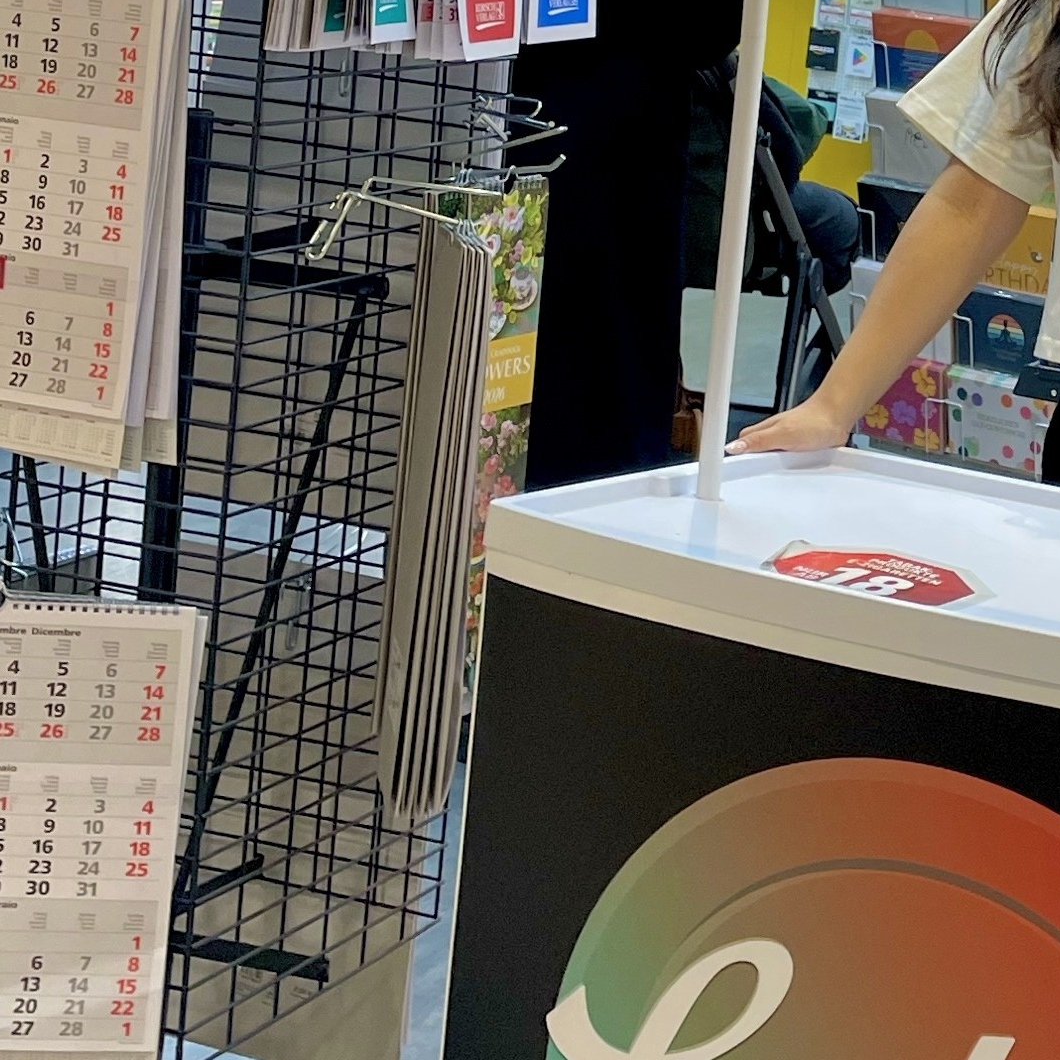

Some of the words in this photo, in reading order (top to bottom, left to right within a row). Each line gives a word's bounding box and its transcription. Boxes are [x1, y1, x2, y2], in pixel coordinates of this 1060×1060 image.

[12, 13, 21, 27] 4
[51, 18, 61, 32] 5
[90, 22, 99, 36] 6
[130, 27, 139, 41] 7
[5, 33, 19, 48] 11
[42, 38, 59, 53] 12
[82, 42, 98, 57] 13
[120, 47, 137, 62] 14
[2, 54, 18, 69] 18
[41, 59, 57, 73] 19
[77, 63, 96, 78] 20
[118, 68, 135, 83] 21
[37, 79, 56, 94] 26
[76, 84, 95, 99] 27
[115, 89, 134, 104] 28
[815, 567, 915, 597] 18
[32, 628, 81, 637] Dicembre
[8, 660, 20, 674] 4
[57, 662, 69, 676] 5
[106, 663, 117, 678] 6
[155, 665, 166, 679] 7
[47, 682, 67, 697] 12
[95, 684, 115, 698] 13
[143, 685, 164, 700] 14
[44, 703, 66, 718] 19
[89, 705, 114, 720] 20
[141, 706, 162, 721] 21
[40, 724, 63, 738] 26
[89, 725, 113, 740] 27
[137, 727, 161, 742] 28
